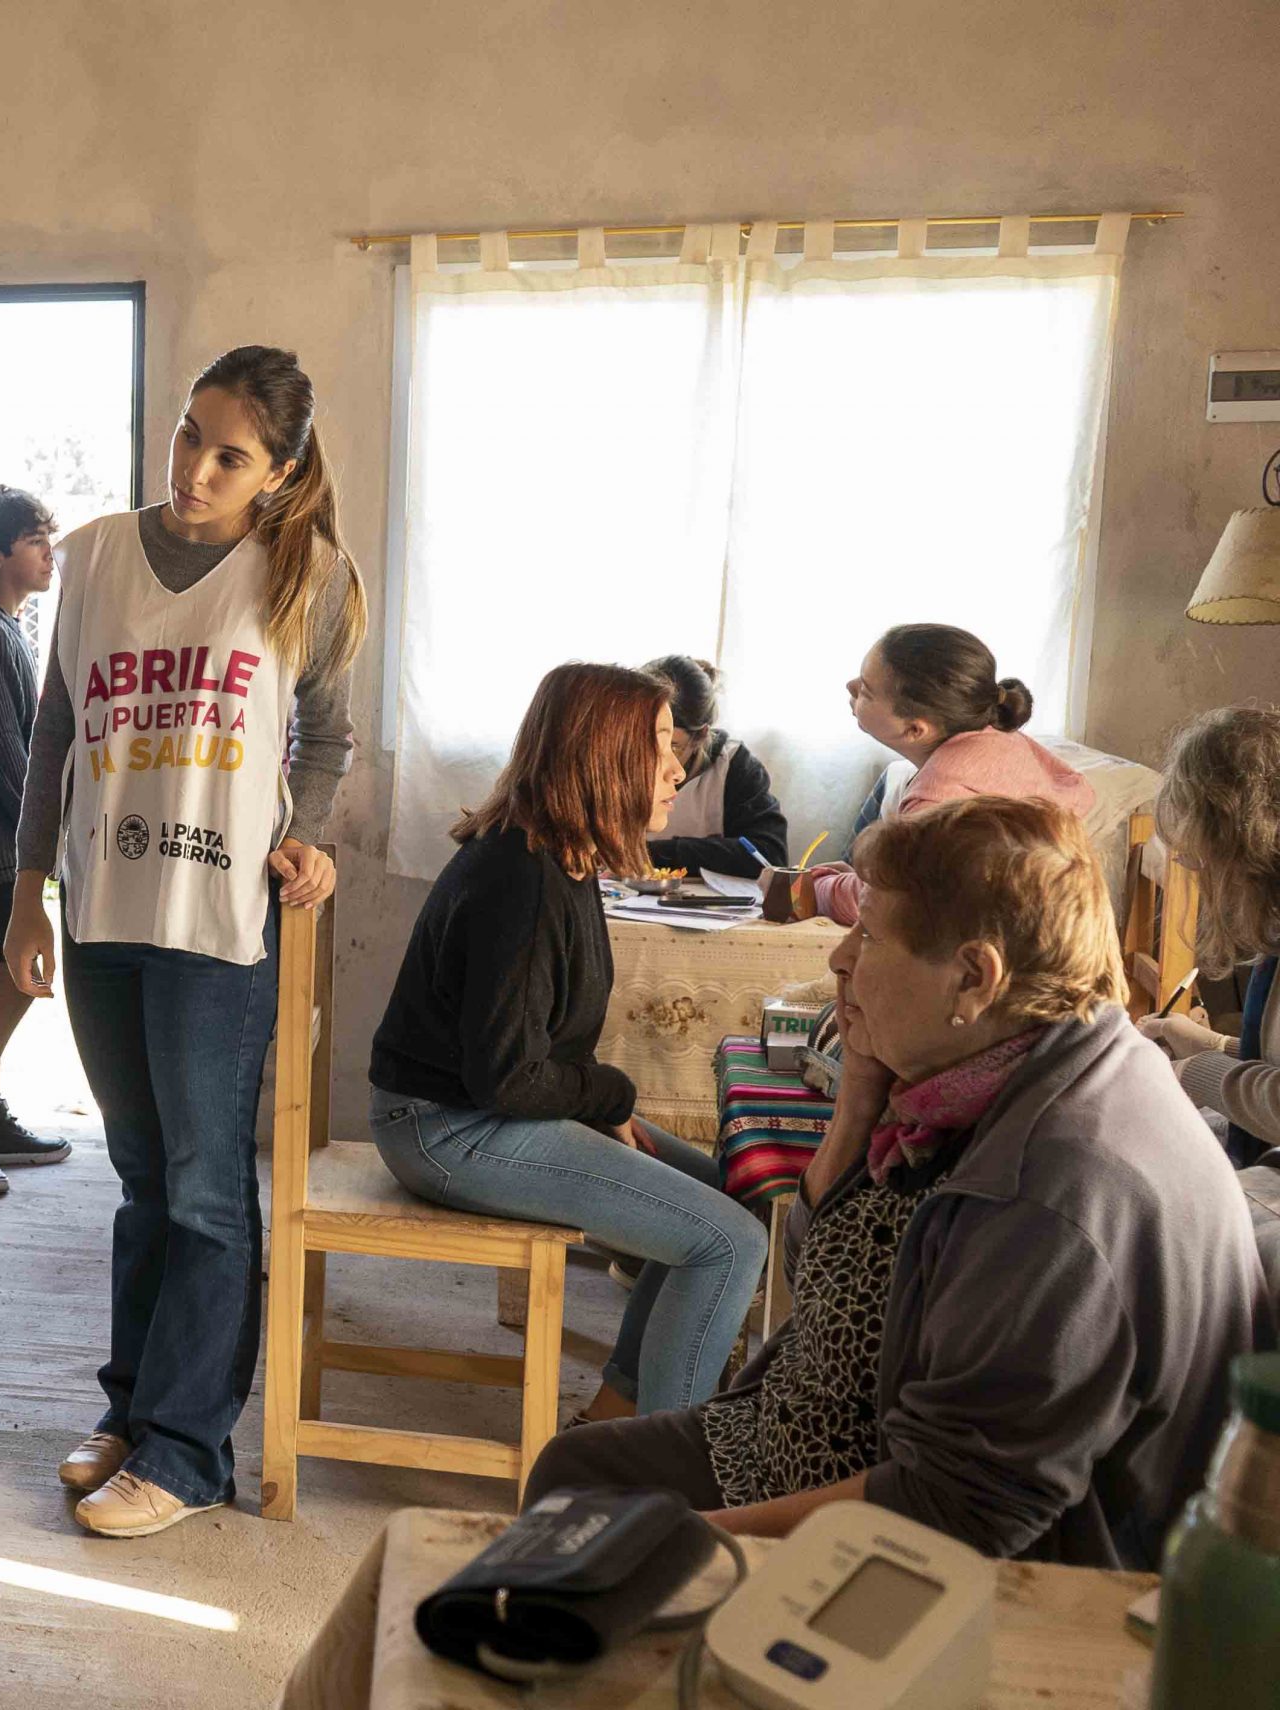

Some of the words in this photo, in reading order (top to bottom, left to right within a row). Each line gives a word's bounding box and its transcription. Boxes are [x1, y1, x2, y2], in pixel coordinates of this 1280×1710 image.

[83, 646, 261, 710] ABRILE
[112, 700, 221, 733] PUERTA
[230, 708, 246, 734] A
[128, 733, 244, 771] SALUD
[174, 823, 224, 851] PATA
